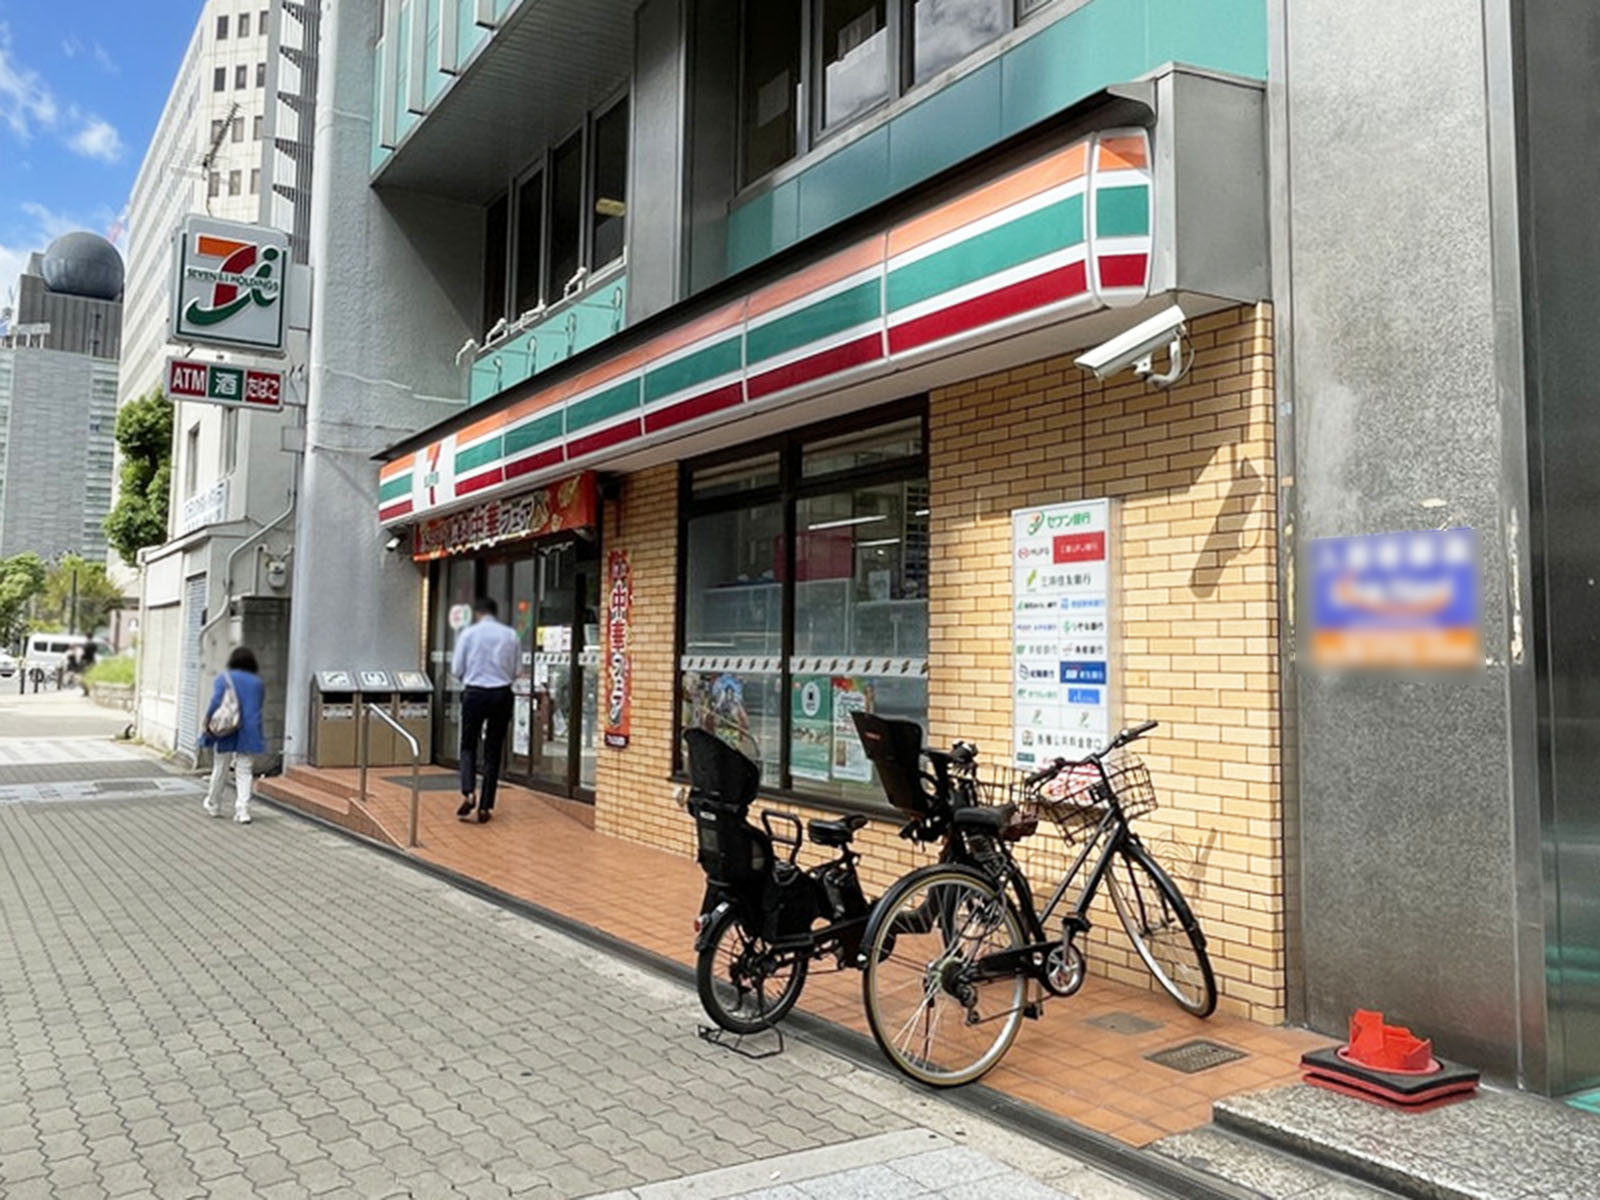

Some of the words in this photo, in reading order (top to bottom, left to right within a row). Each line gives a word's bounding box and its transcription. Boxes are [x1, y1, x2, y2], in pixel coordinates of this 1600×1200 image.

[172, 367, 205, 392] ATM
[215, 372, 238, 396] 酒
[247, 377, 279, 400] たばこ
